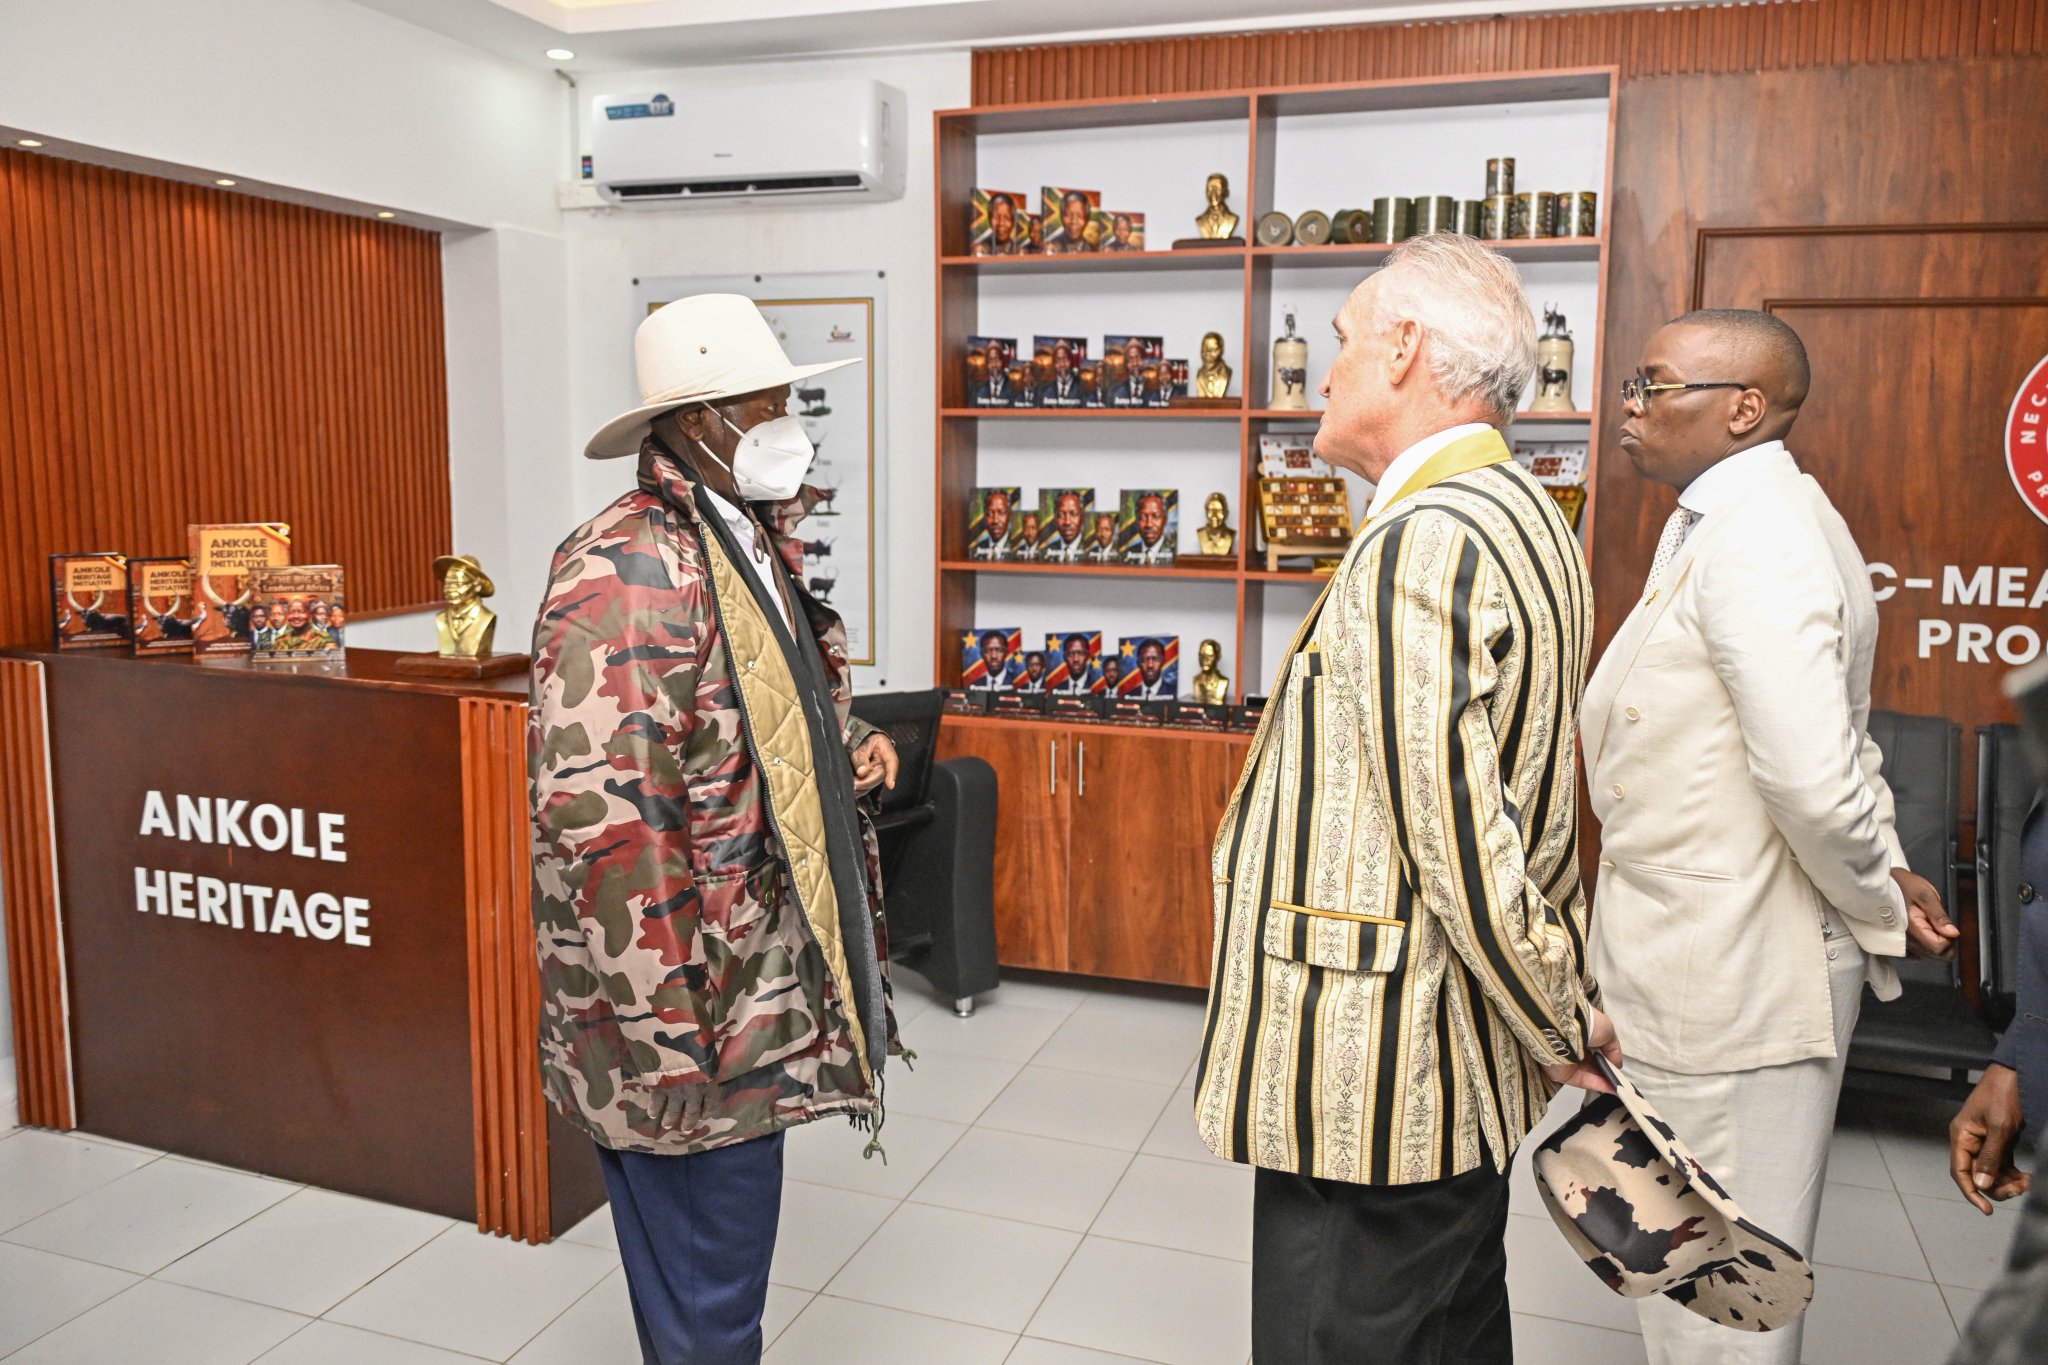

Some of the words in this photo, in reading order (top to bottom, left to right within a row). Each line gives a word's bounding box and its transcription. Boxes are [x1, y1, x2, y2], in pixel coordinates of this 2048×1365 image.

[2020, 381, 2048, 444] NEC
[210, 549, 269, 558] HERITAGE
[210, 559, 269, 568] INITIATIVE
[211, 538, 268, 548] ANKOLE
[1918, 619, 2048, 666] PRO
[139, 790, 348, 863] ANKOLE
[134, 866, 372, 947] HERITAGE
